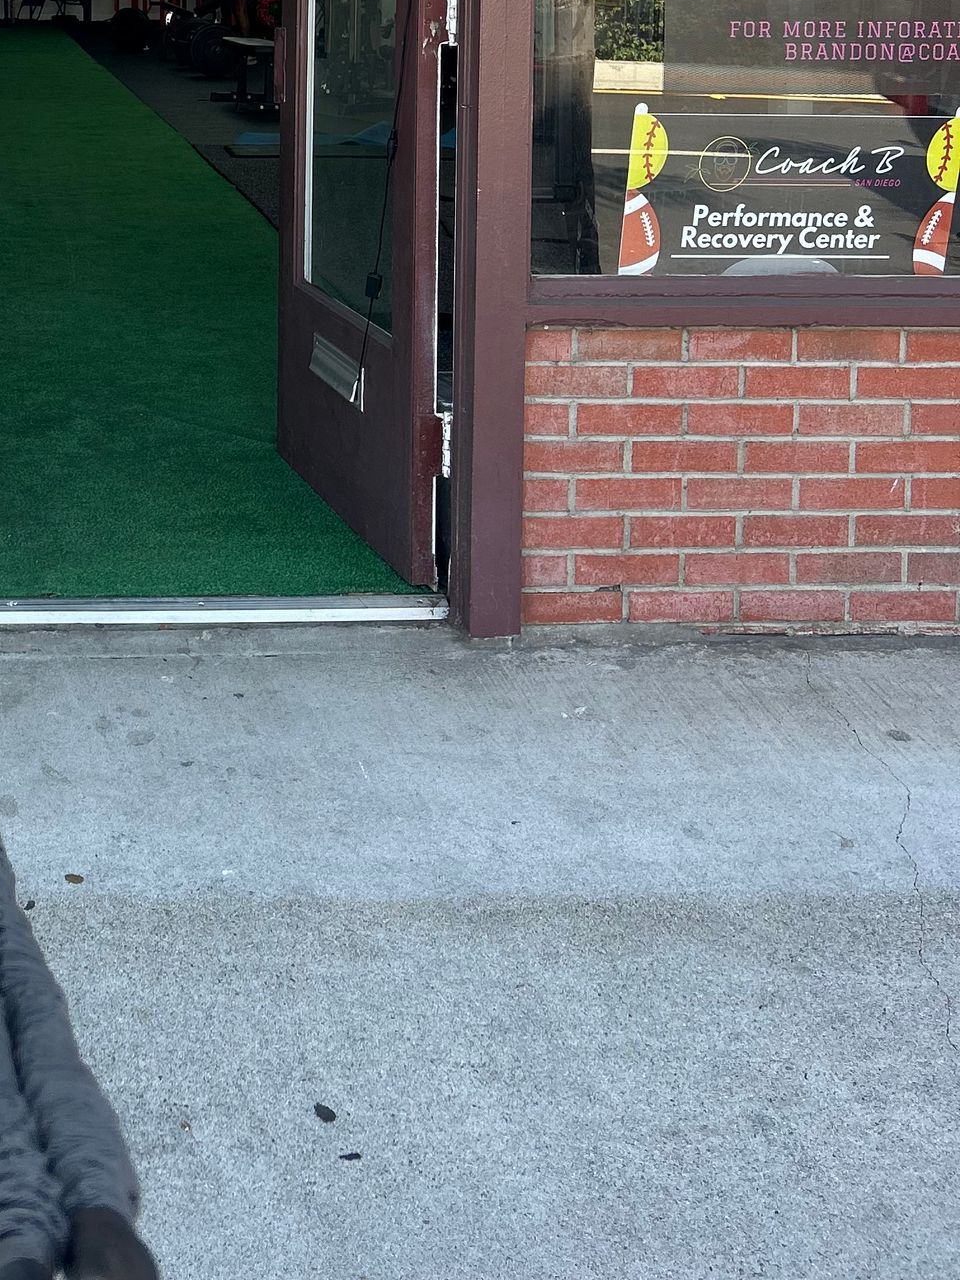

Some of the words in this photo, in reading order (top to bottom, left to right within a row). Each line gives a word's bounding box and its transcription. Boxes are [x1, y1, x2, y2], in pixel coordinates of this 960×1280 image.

[730, 21, 771, 39] FOR
[783, 21, 846, 39] MORE
[755, 146, 865, 175] Coach
[871, 146, 905, 174] B
[854, 178, 873, 187] SAN
[875, 178, 901, 187] DIEGO
[692, 204, 848, 228] Performance
[854, 205, 875, 228] &
[681, 226, 793, 255] Recovery
[799, 226, 881, 249] Center
